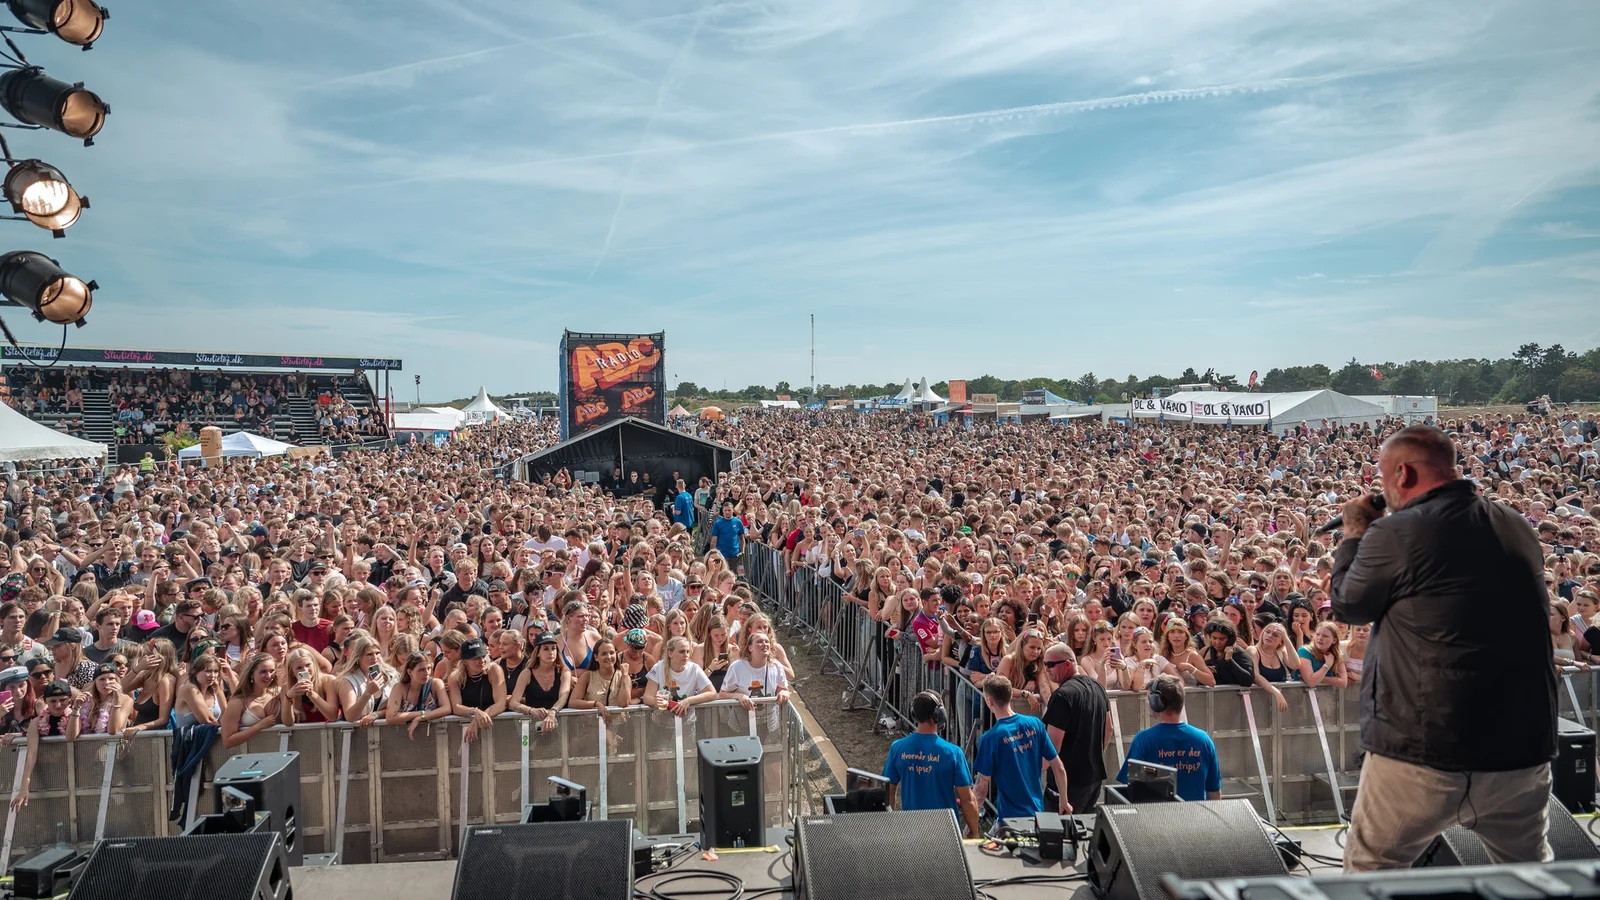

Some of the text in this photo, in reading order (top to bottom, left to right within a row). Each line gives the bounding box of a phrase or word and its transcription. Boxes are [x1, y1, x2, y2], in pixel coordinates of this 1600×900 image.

[596, 349, 640, 369] RADIO
[1147, 400, 1155, 410] &
[1160, 400, 1187, 413] VAND
[1204, 404, 1218, 416] ØL
[1221, 403, 1230, 416] &
[1232, 403, 1264, 416] VAND
[901, 751, 926, 761] Hvornår
[1158, 749, 1175, 757] Hvor
[1188, 747, 1201, 757] der
[1175, 761, 1200, 773] strips?
